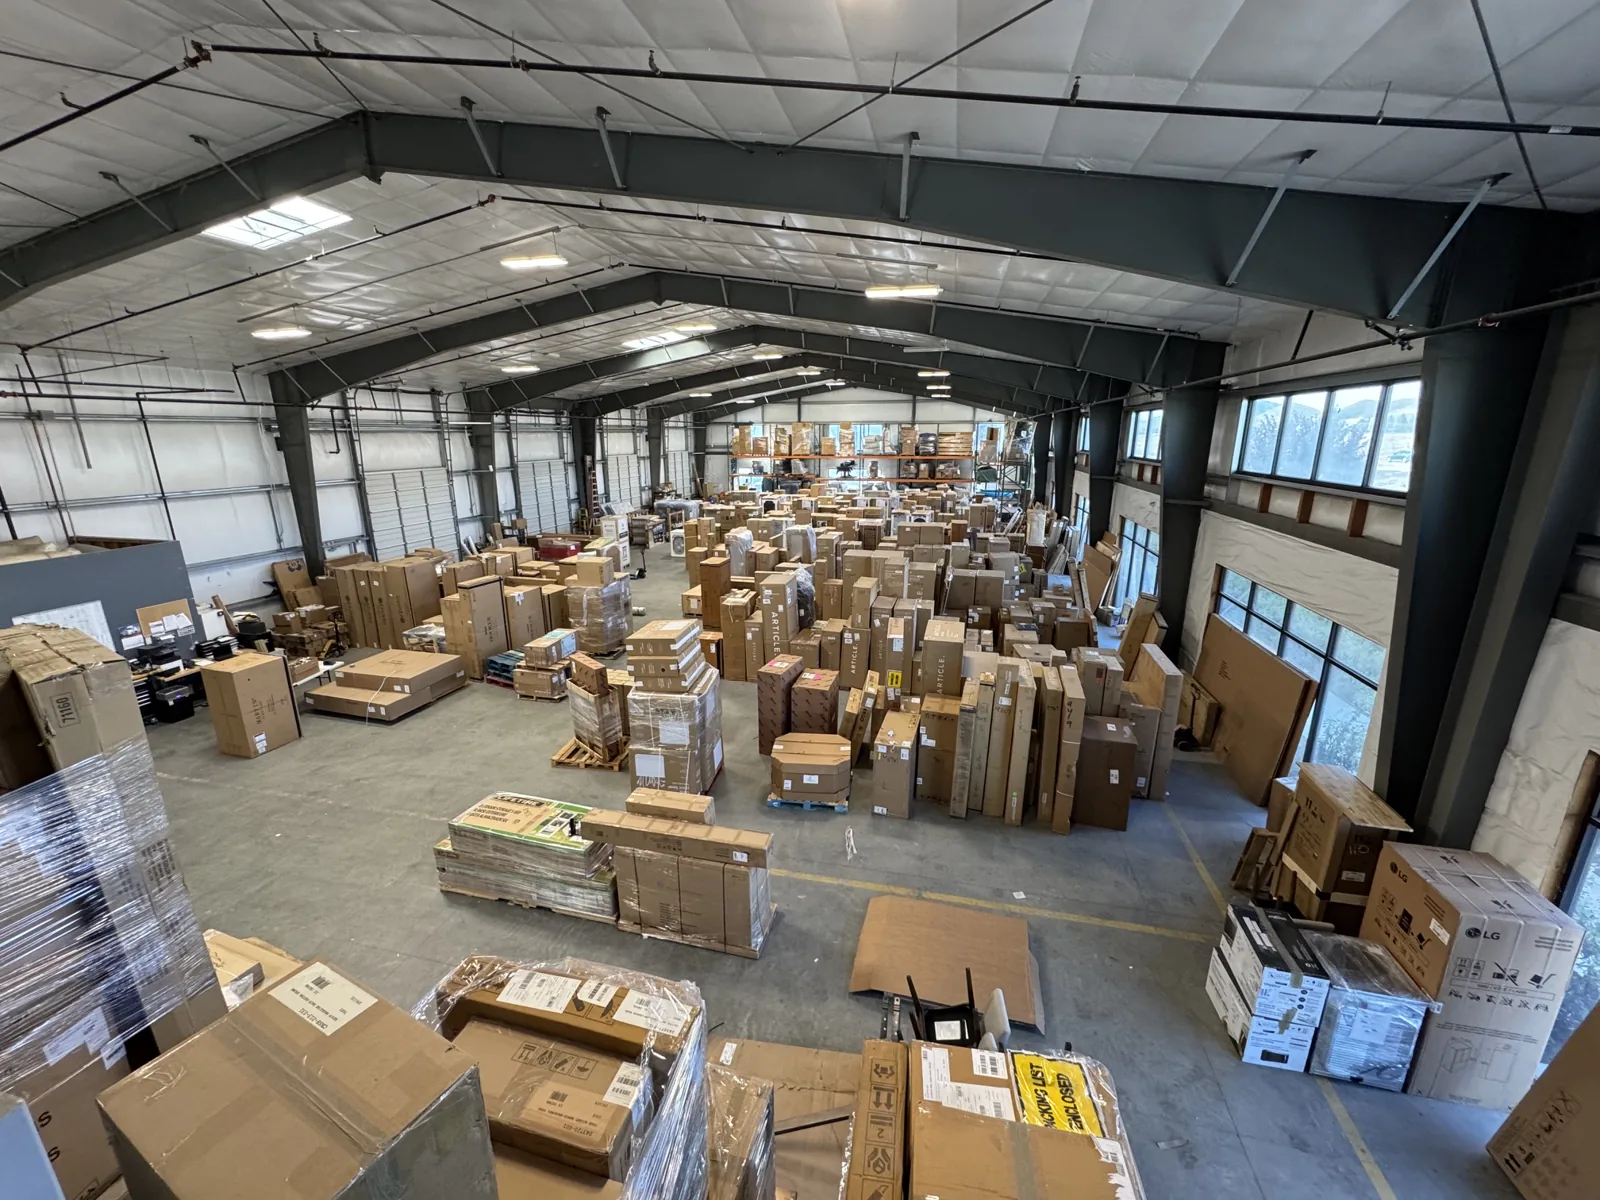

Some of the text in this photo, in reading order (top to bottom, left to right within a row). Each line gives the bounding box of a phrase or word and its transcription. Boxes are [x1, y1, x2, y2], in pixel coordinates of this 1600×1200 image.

[850, 643, 859, 674] ARTICLE.
[56, 697, 76, 724] 71160
[1483, 931, 1501, 940] LG
[1029, 1062, 1046, 1087] LIST
